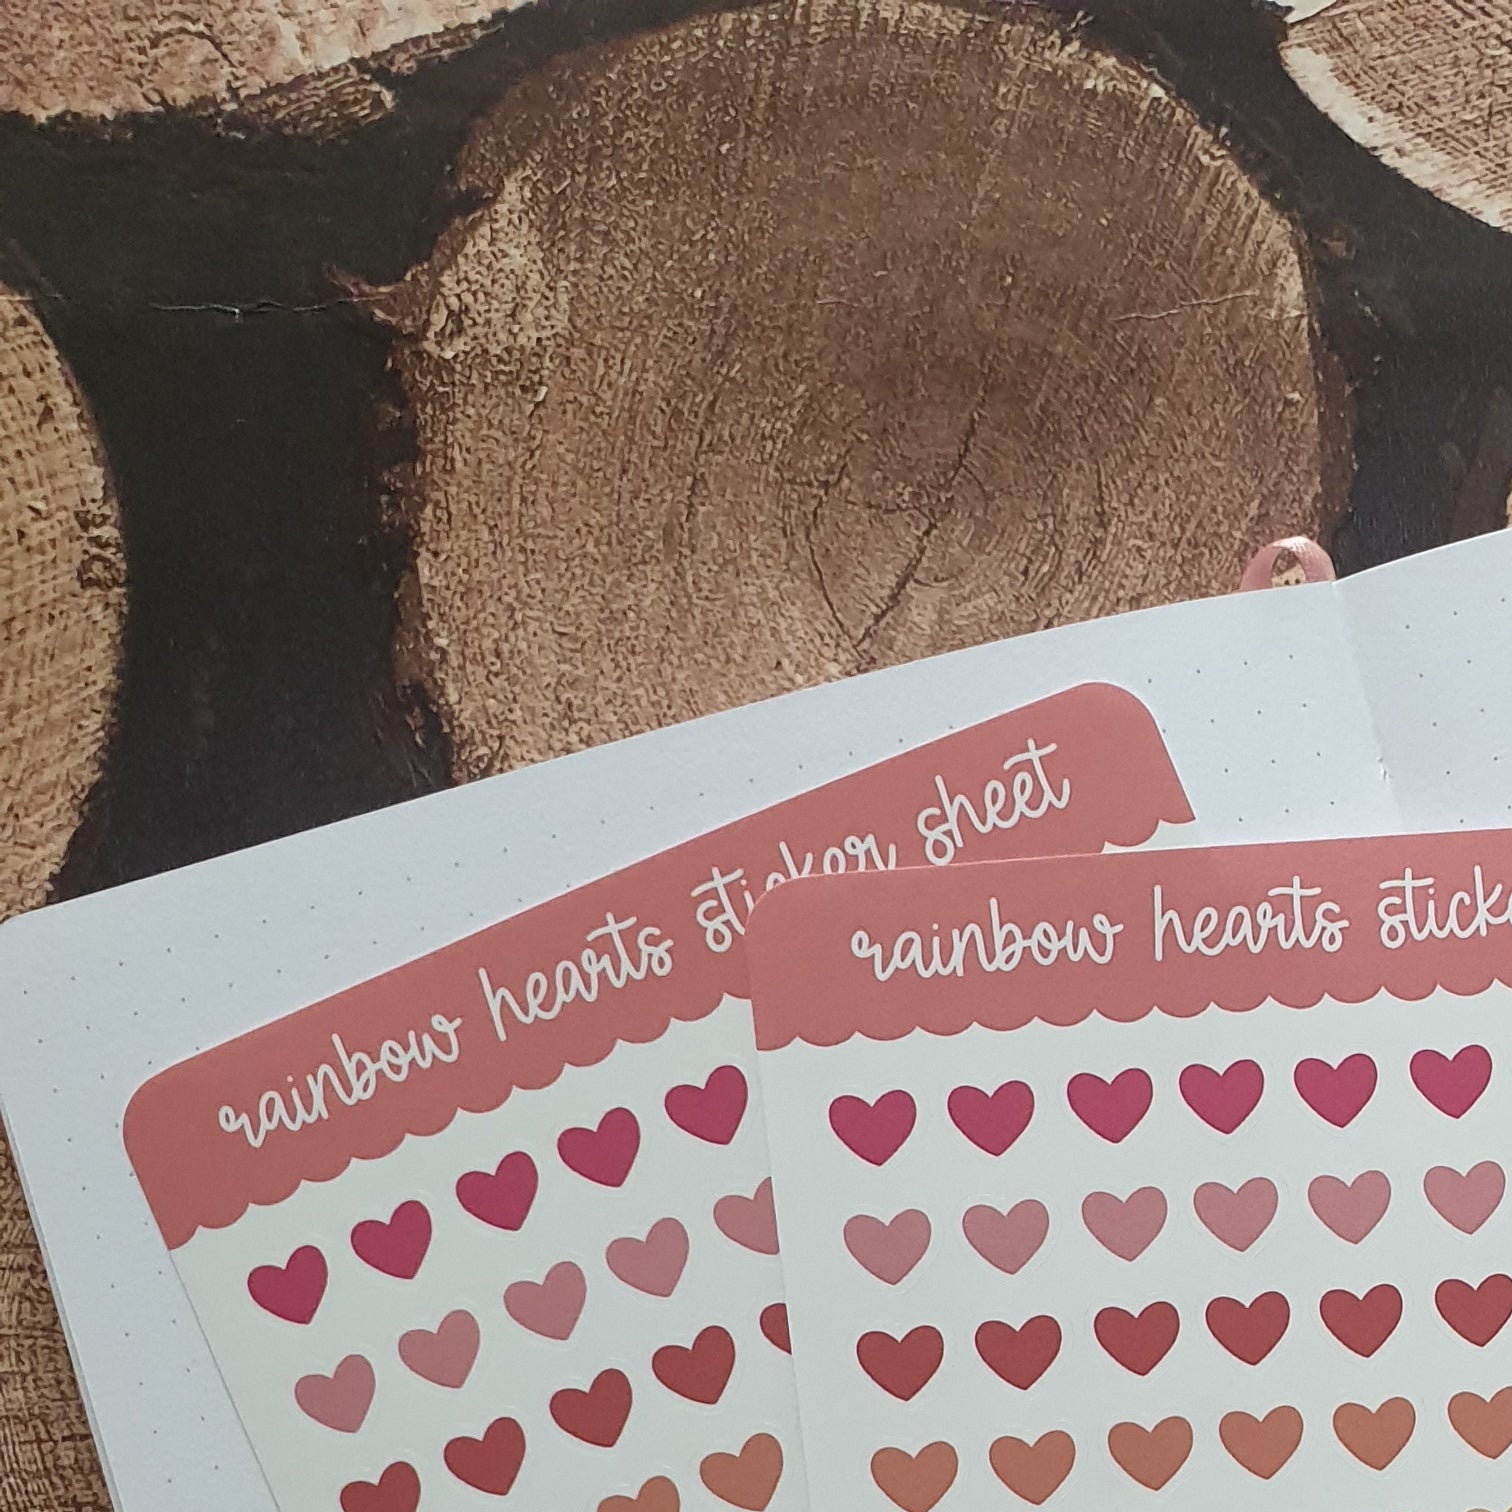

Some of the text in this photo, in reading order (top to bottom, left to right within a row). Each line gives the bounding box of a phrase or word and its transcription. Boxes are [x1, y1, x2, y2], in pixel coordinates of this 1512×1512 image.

[218, 1012, 463, 1149] rainbow
[478, 912, 674, 1042] hearts
[917, 737, 1071, 867] sheet
[851, 896, 1125, 982] rainbow
[1153, 875, 1350, 953] hearts
